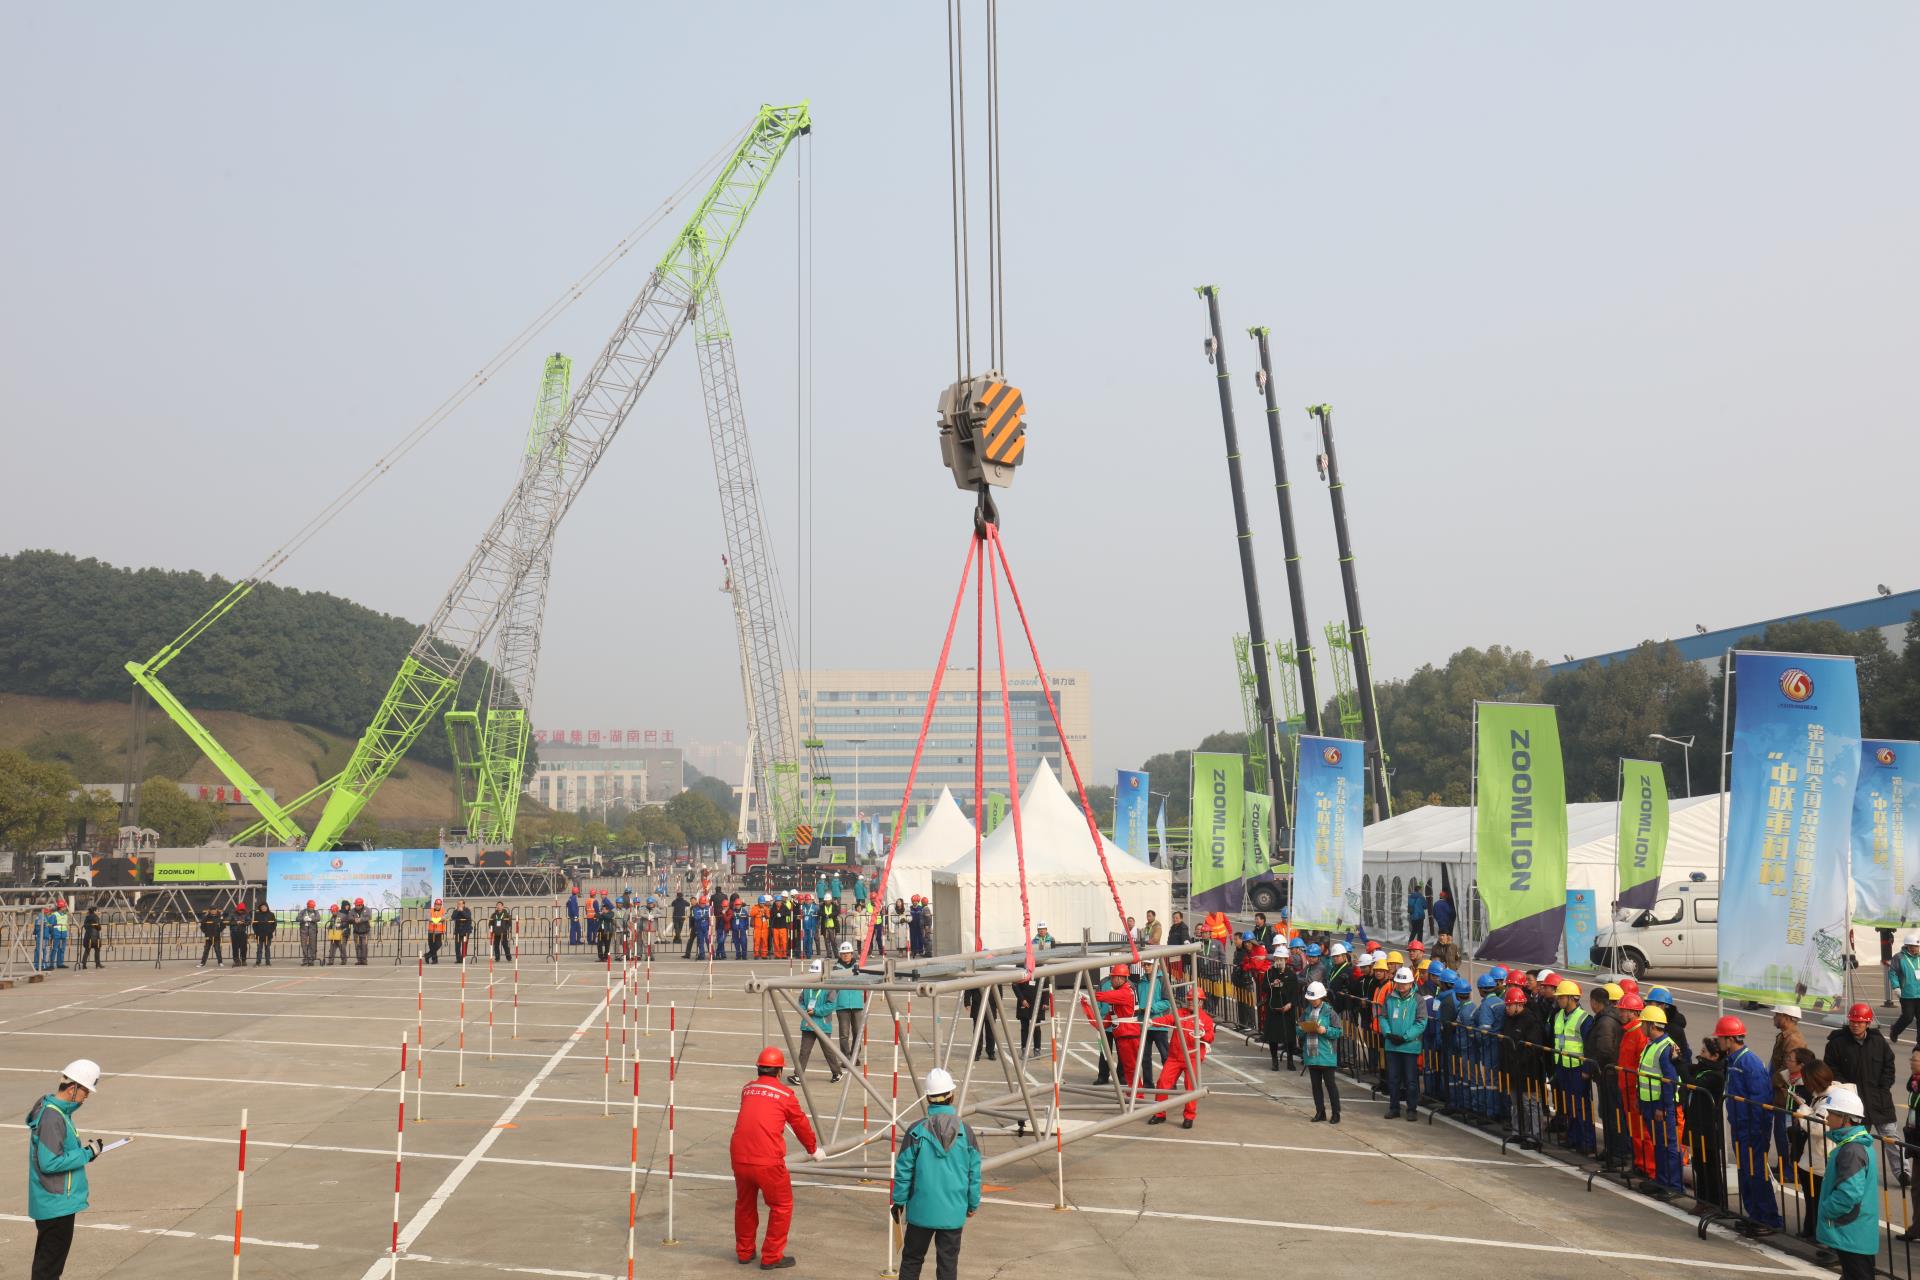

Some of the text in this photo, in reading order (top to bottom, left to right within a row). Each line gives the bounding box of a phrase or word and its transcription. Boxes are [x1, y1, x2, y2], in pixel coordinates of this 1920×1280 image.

[1211, 768, 1226, 869] ZOOMLION
[1510, 729, 1533, 891] ZOOMLION
[1633, 775, 1653, 868] ZOOMLION
